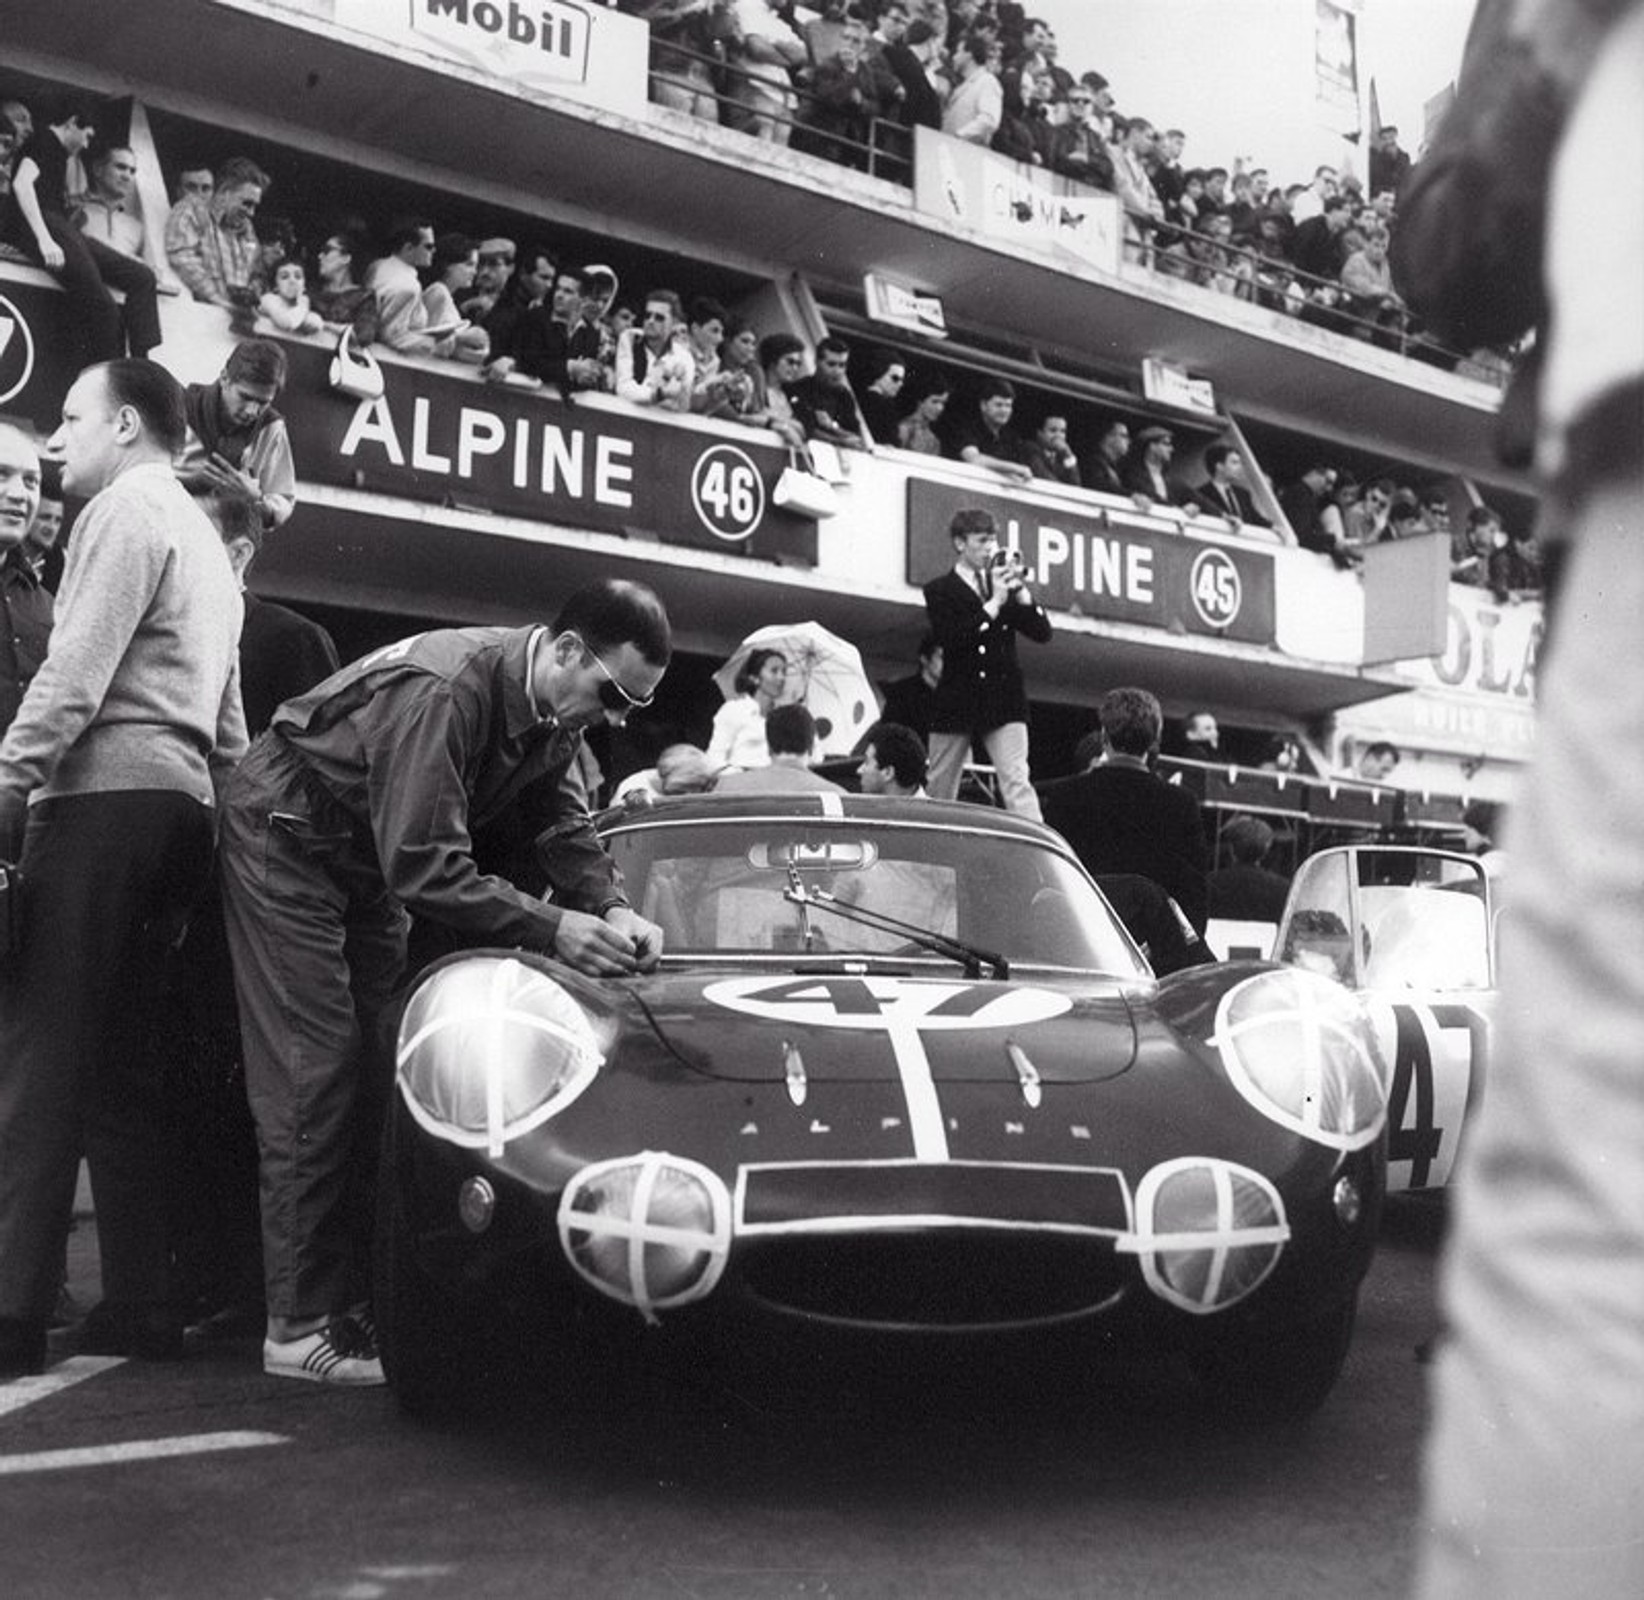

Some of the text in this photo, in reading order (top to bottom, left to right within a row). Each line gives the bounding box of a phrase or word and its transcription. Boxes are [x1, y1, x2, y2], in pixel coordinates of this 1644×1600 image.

[340, 396, 755, 524] ALPINE 46
[1007, 519, 1235, 614] LPINE 45
[736, 978, 1018, 1018] 47
[1387, 1004, 1489, 1189] 47
